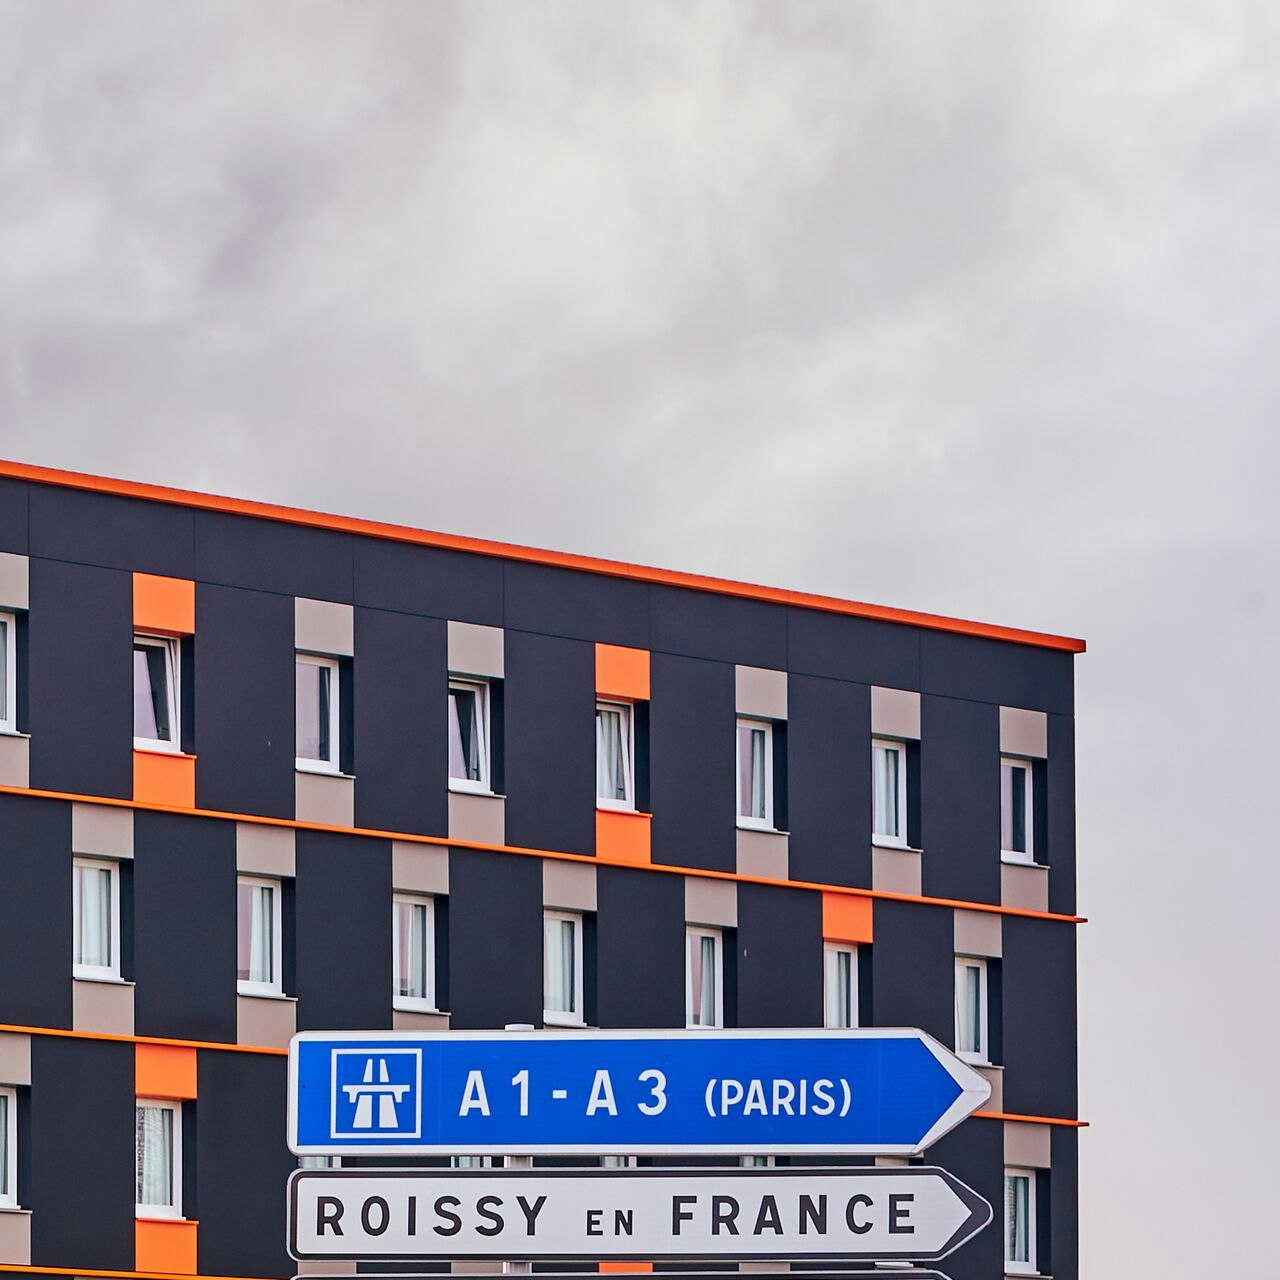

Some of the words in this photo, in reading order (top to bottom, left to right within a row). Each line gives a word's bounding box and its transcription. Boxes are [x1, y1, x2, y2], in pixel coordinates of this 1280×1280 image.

[705, 1078, 851, 1117] (PARIS)
[316, 1195, 548, 1237] ROISSY
[586, 1209, 633, 1236] EN
[672, 1193, 915, 1236] FRANCE
